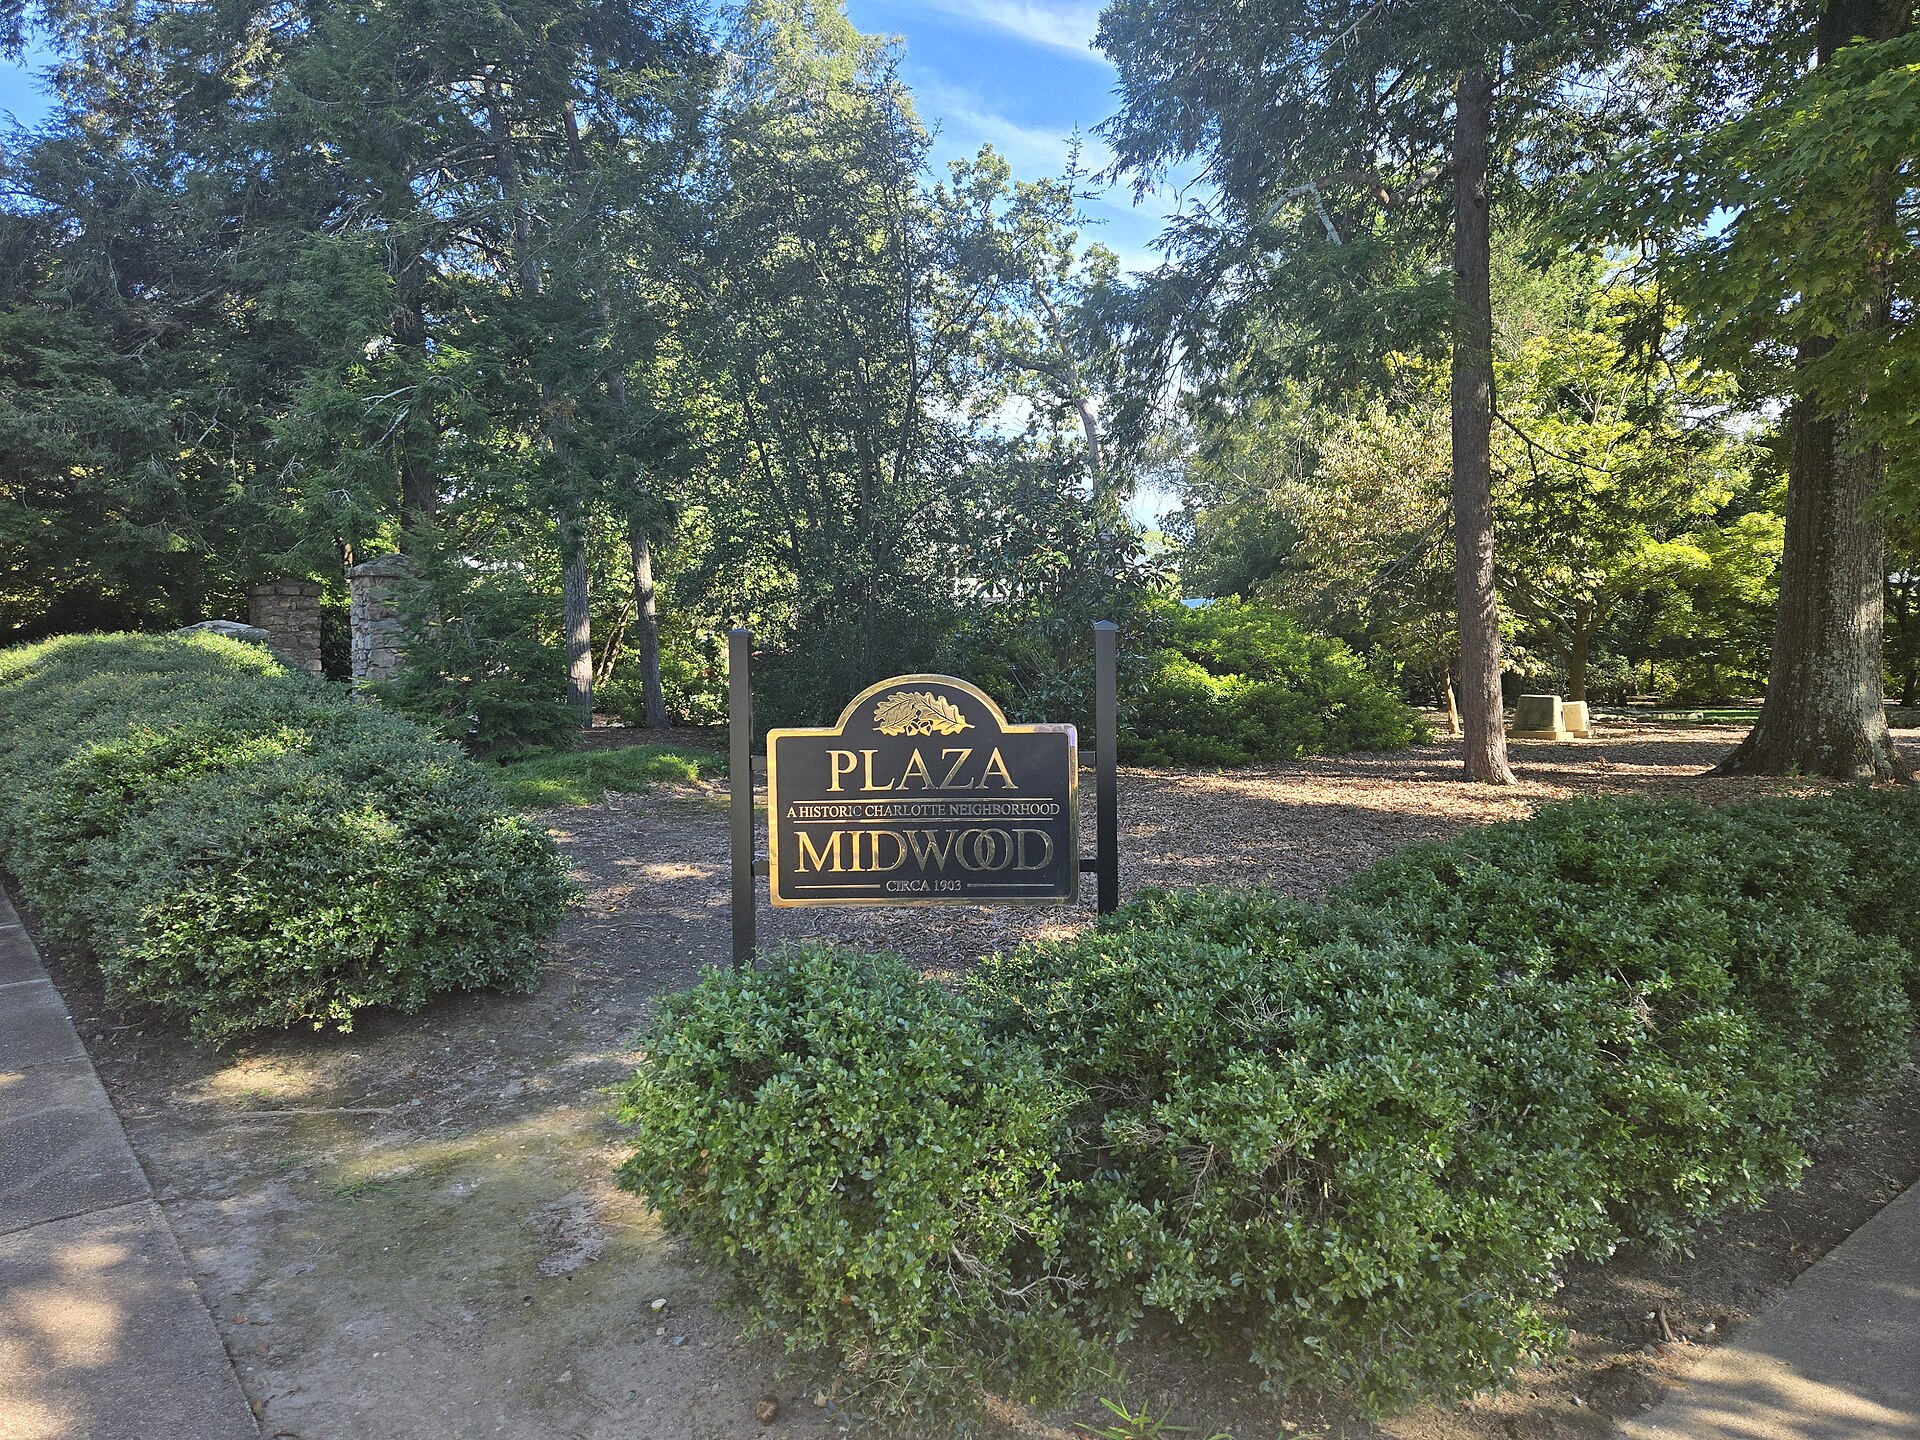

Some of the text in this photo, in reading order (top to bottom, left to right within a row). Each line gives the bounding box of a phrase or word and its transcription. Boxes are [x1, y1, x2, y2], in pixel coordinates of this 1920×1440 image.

[825, 746, 1019, 792] PLAZA
[786, 803, 1060, 818] A HISTORIC CHARLOTTE NEIGHBORHOOD
[794, 827, 1055, 873] MIDWOOD
[886, 879, 962, 892] CIRCA 1903
